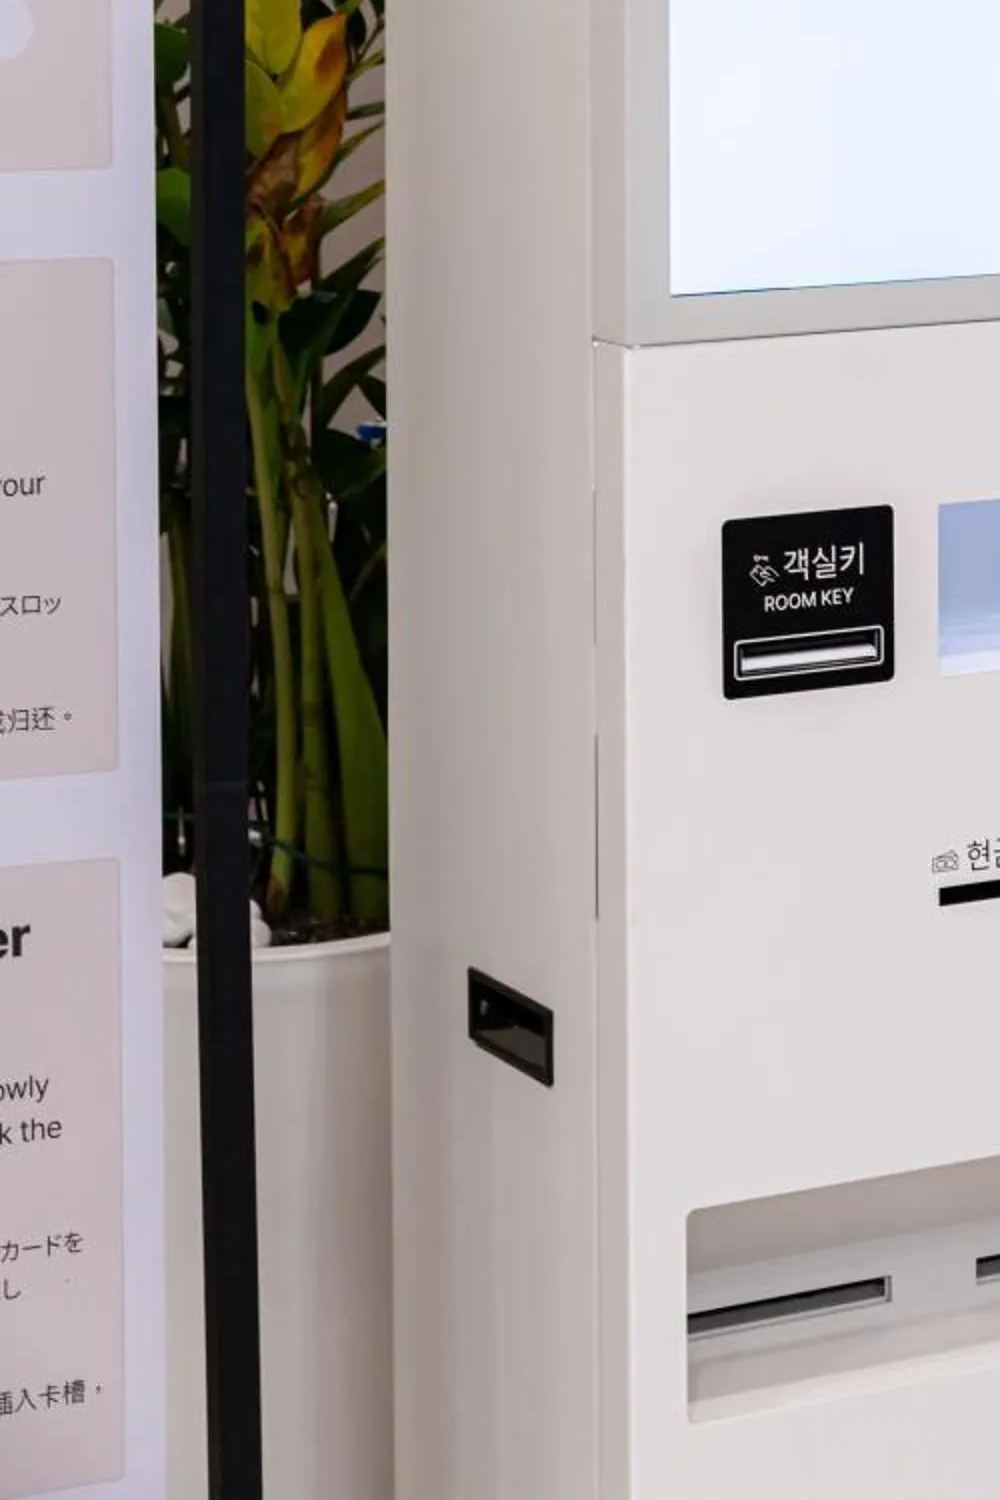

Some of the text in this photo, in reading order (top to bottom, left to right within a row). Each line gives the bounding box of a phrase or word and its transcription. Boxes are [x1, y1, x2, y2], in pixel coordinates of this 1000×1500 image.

[0, 475, 45, 497] our
[783, 541, 865, 581] 객실키
[764, 586, 854, 613] ROOM KEY
[20, 1117, 63, 1143] the
